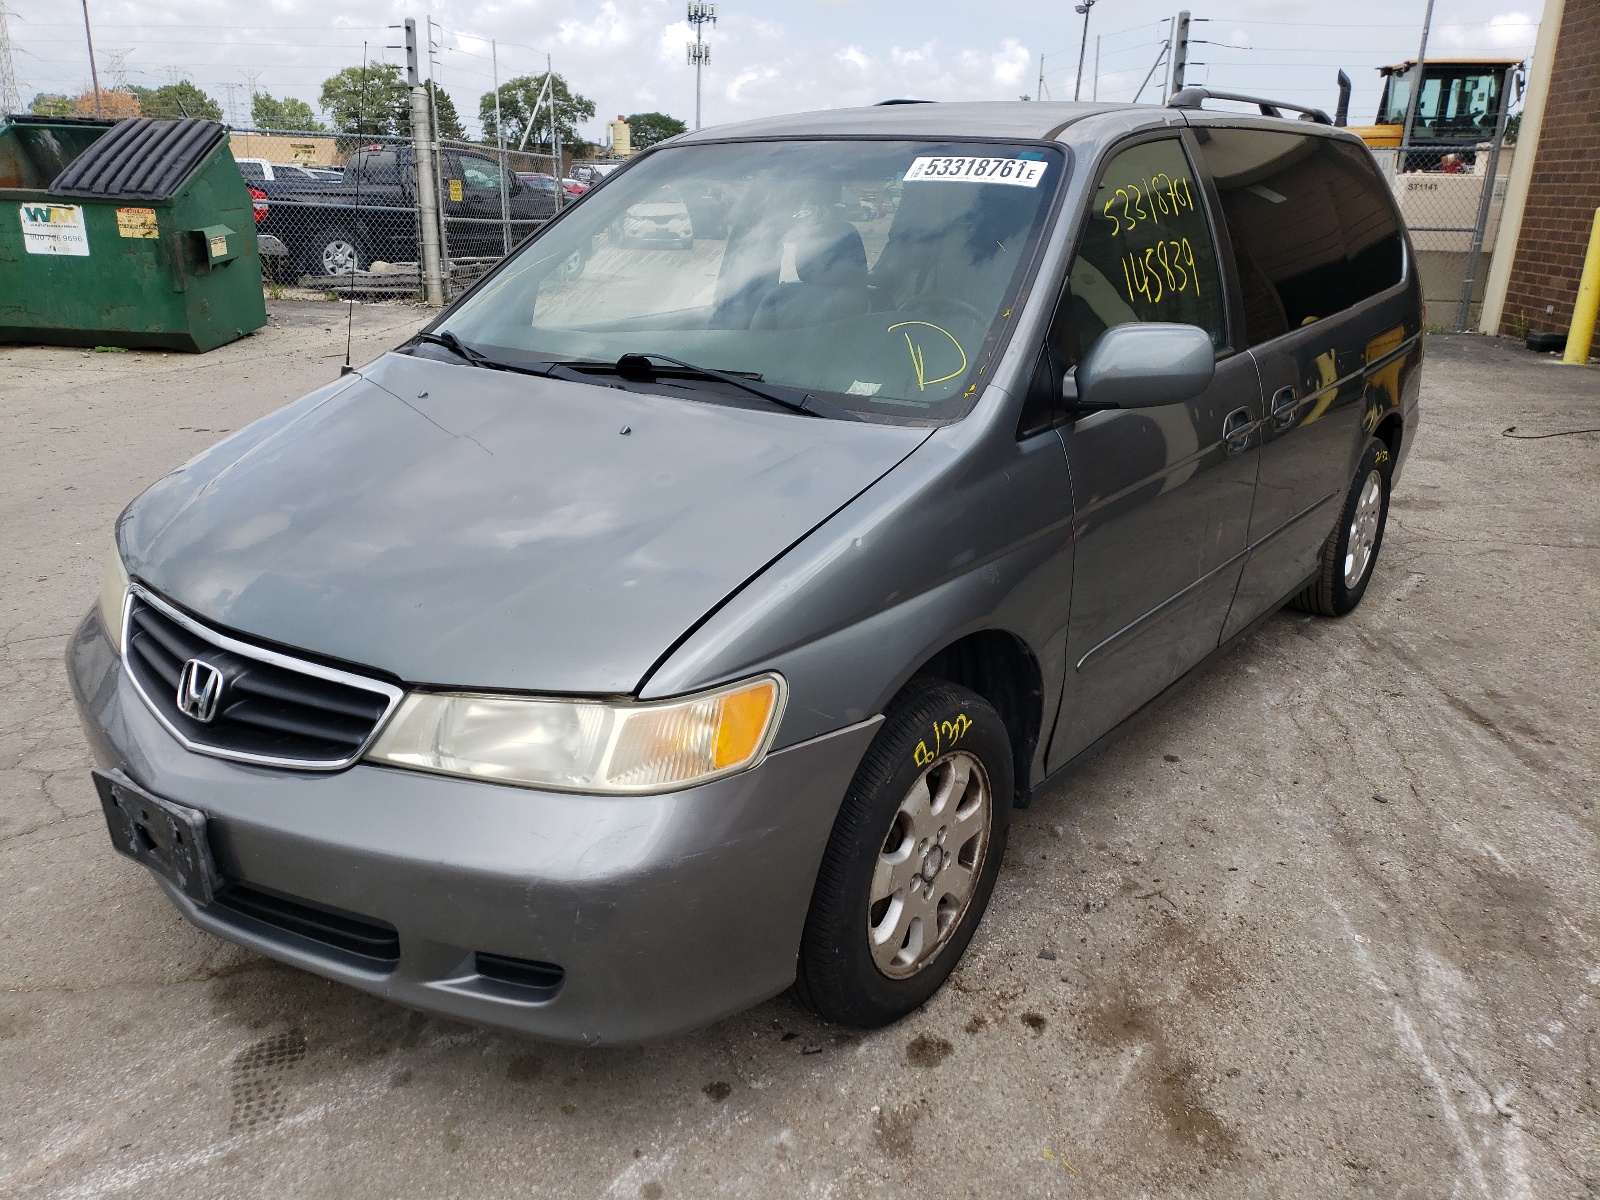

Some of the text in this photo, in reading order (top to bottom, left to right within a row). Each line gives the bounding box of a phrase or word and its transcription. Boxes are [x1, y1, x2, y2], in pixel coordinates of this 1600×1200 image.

[924, 158, 1028, 179] 53318761
[1026, 169, 1037, 180] E
[1407, 183, 1438, 191] ST1141
[24, 207, 78, 224] WM
[1103, 173, 1194, 236] 53318761
[1121, 237, 1200, 303] 145839
